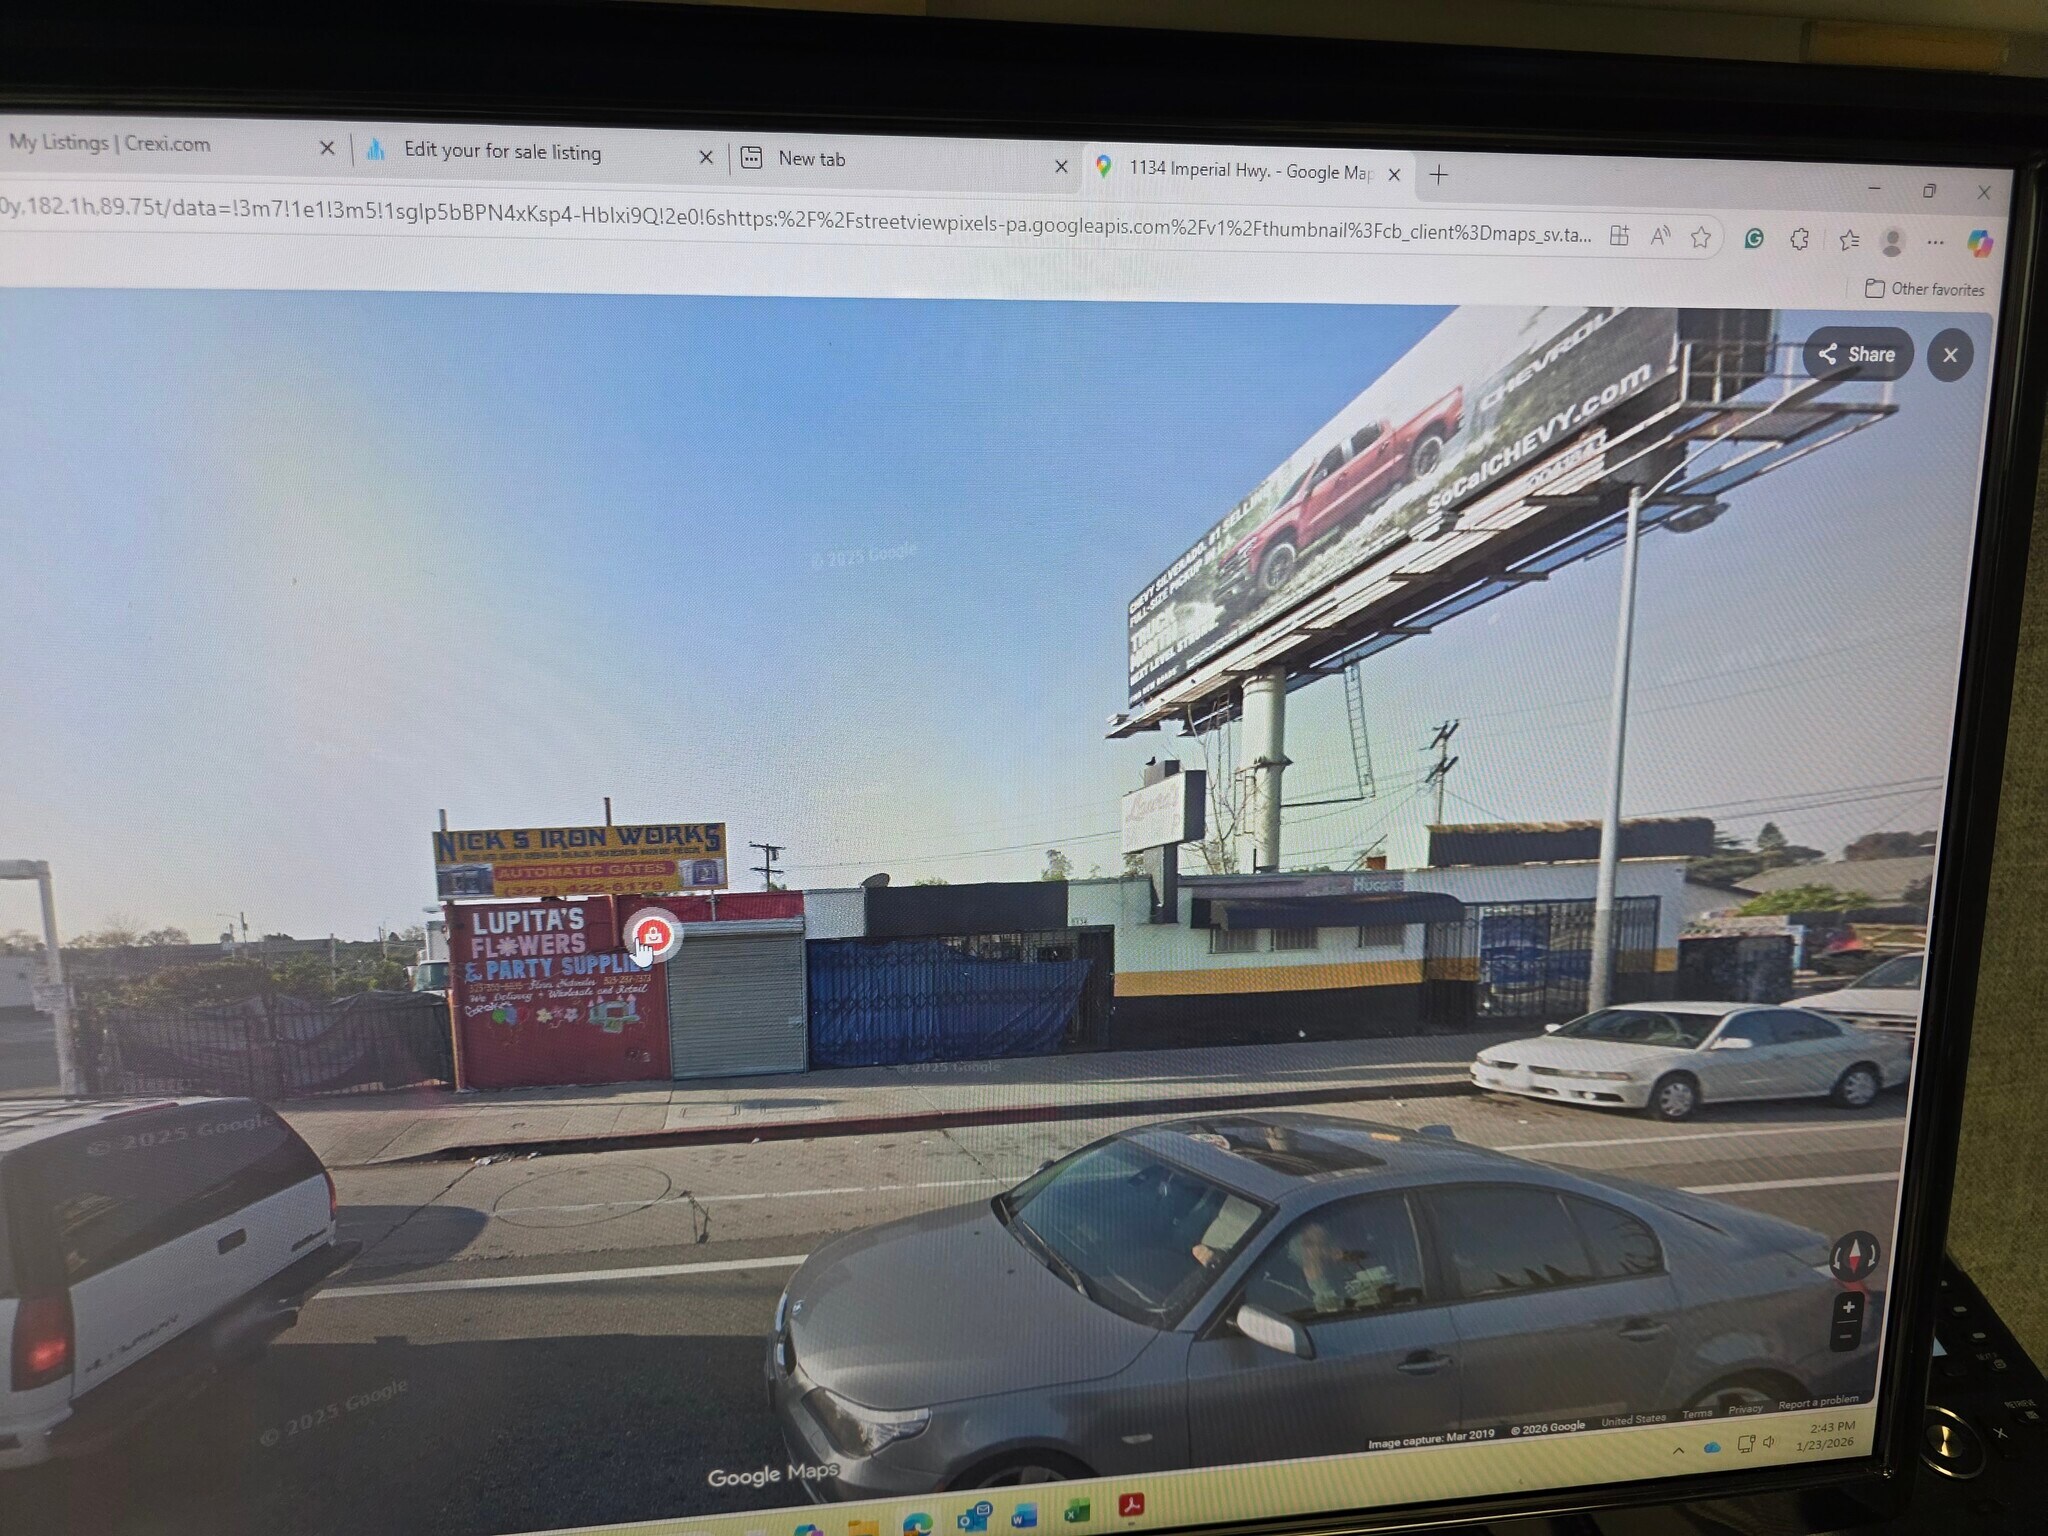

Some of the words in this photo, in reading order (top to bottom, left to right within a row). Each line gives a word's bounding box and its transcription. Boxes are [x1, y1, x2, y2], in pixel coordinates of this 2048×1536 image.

[9, 133, 41, 157] My
[43, 133, 110, 157] Listings
[125, 135, 211, 154] Crexi.com
[404, 140, 437, 158] Edit
[442, 145, 480, 163] your
[484, 141, 509, 160] for
[514, 142, 547, 161] sale
[551, 142, 602, 166] listing
[779, 150, 815, 167] New
[819, 151, 846, 168] tab
[1131, 159, 1167, 175] 1134
[1171, 161, 1231, 179] Imperial
[1236, 163, 1271, 181] Hwy.
[1287, 164, 1340, 183] Google
[1891, 281, 1932, 297] Other
[1933, 281, 1985, 298] favorites
[1848, 345, 1896, 364] Share
[540, 829, 607, 850] IRON
[615, 824, 722, 851] WORKS
[500, 864, 603, 879] AUTOMATIC
[608, 862, 667, 876] GATES
[472, 907, 585, 936] LUPITA'S
[486, 958, 552, 981] PARTY
[597, 986, 614, 995] and
[124, 1127, 187, 1150] 2025
[199, 1113, 275, 1137] Google
[286, 1403, 338, 1436] 2025
[346, 1378, 408, 1412] Google
[1728, 1404, 1763, 1416] Privacy
[1778, 1399, 1811, 1411] Report
[1821, 1394, 1859, 1408] problem
[1601, 1415, 1634, 1427] United
[1635, 1413, 1667, 1424] States
[1683, 1409, 1713, 1420] Terms
[1368, 1438, 1401, 1450] Image
[1402, 1433, 1445, 1448] capture:
[1446, 1431, 1467, 1442] Mar
[1469, 1428, 1495, 1440] 2019
[1522, 1424, 1549, 1436] 2026
[1550, 1420, 1586, 1433] Google
[1810, 1423, 1834, 1434] 2:43
[1838, 1420, 1856, 1432] PM
[1796, 1436, 1855, 1452] 1/23/2026
[707, 1464, 781, 1489] Google
[787, 1461, 840, 1483] Maps
